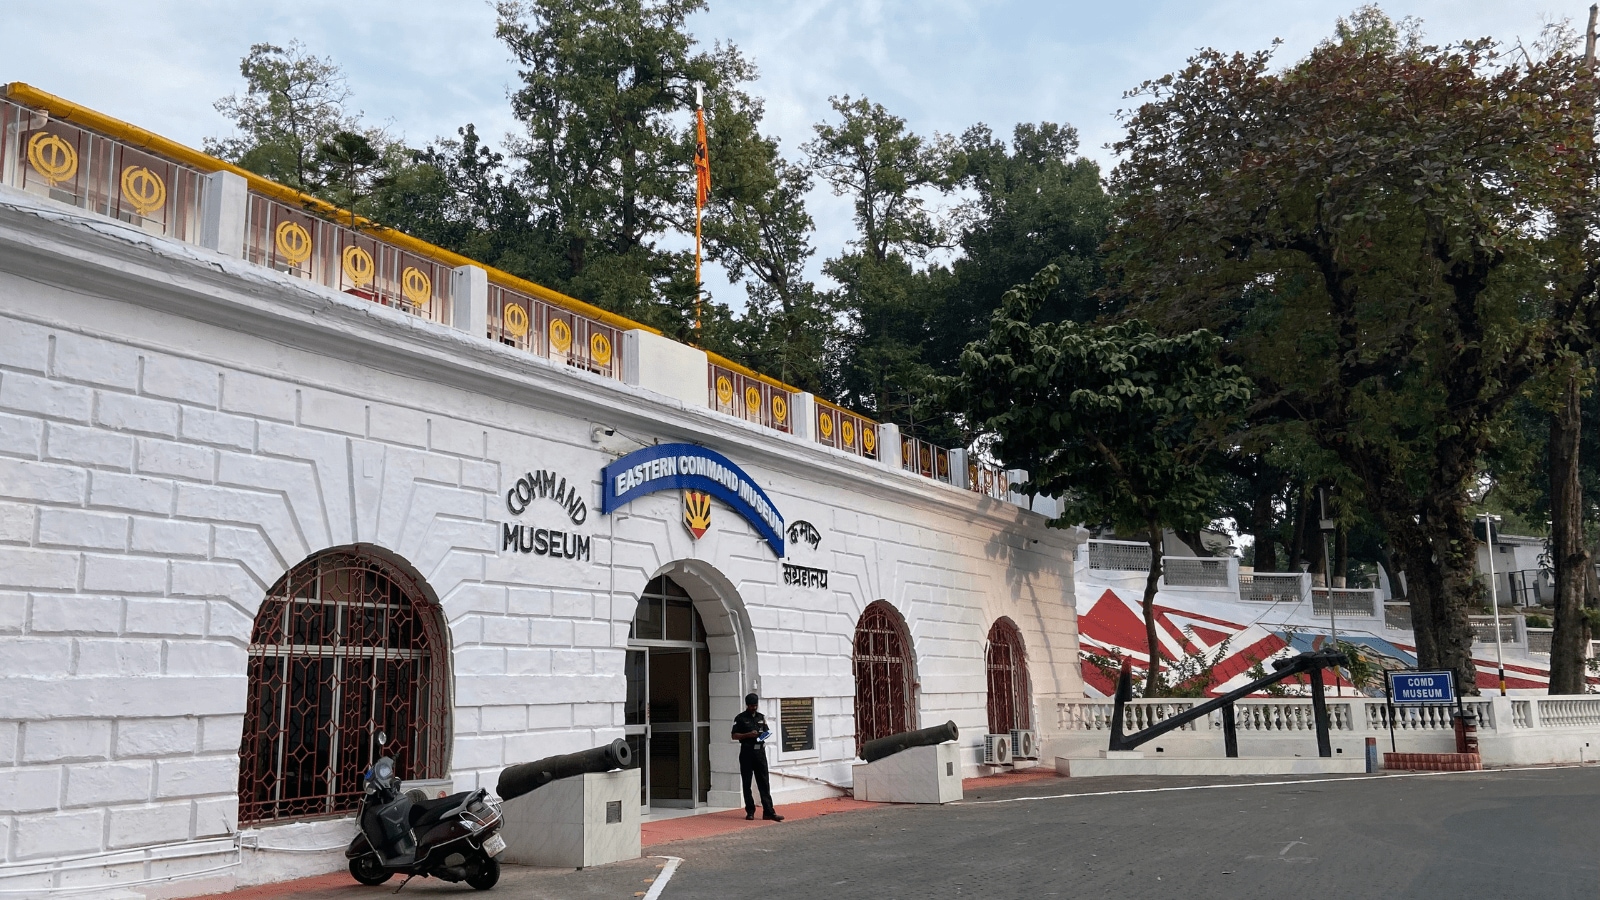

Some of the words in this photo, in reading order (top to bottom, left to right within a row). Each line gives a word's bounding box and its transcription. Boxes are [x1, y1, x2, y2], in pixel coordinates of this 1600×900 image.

[506, 469, 587, 525] COMMAND
[615, 456, 677, 497] EASTERN
[678, 455, 739, 492] COMMAND
[738, 479, 783, 540] MUSEUM
[502, 523, 590, 562] MUSEUM
[782, 556, 828, 590] संग्रहालय
[1402, 688, 1443, 698] MUSEUM
[1407, 677, 1434, 687] COMD
